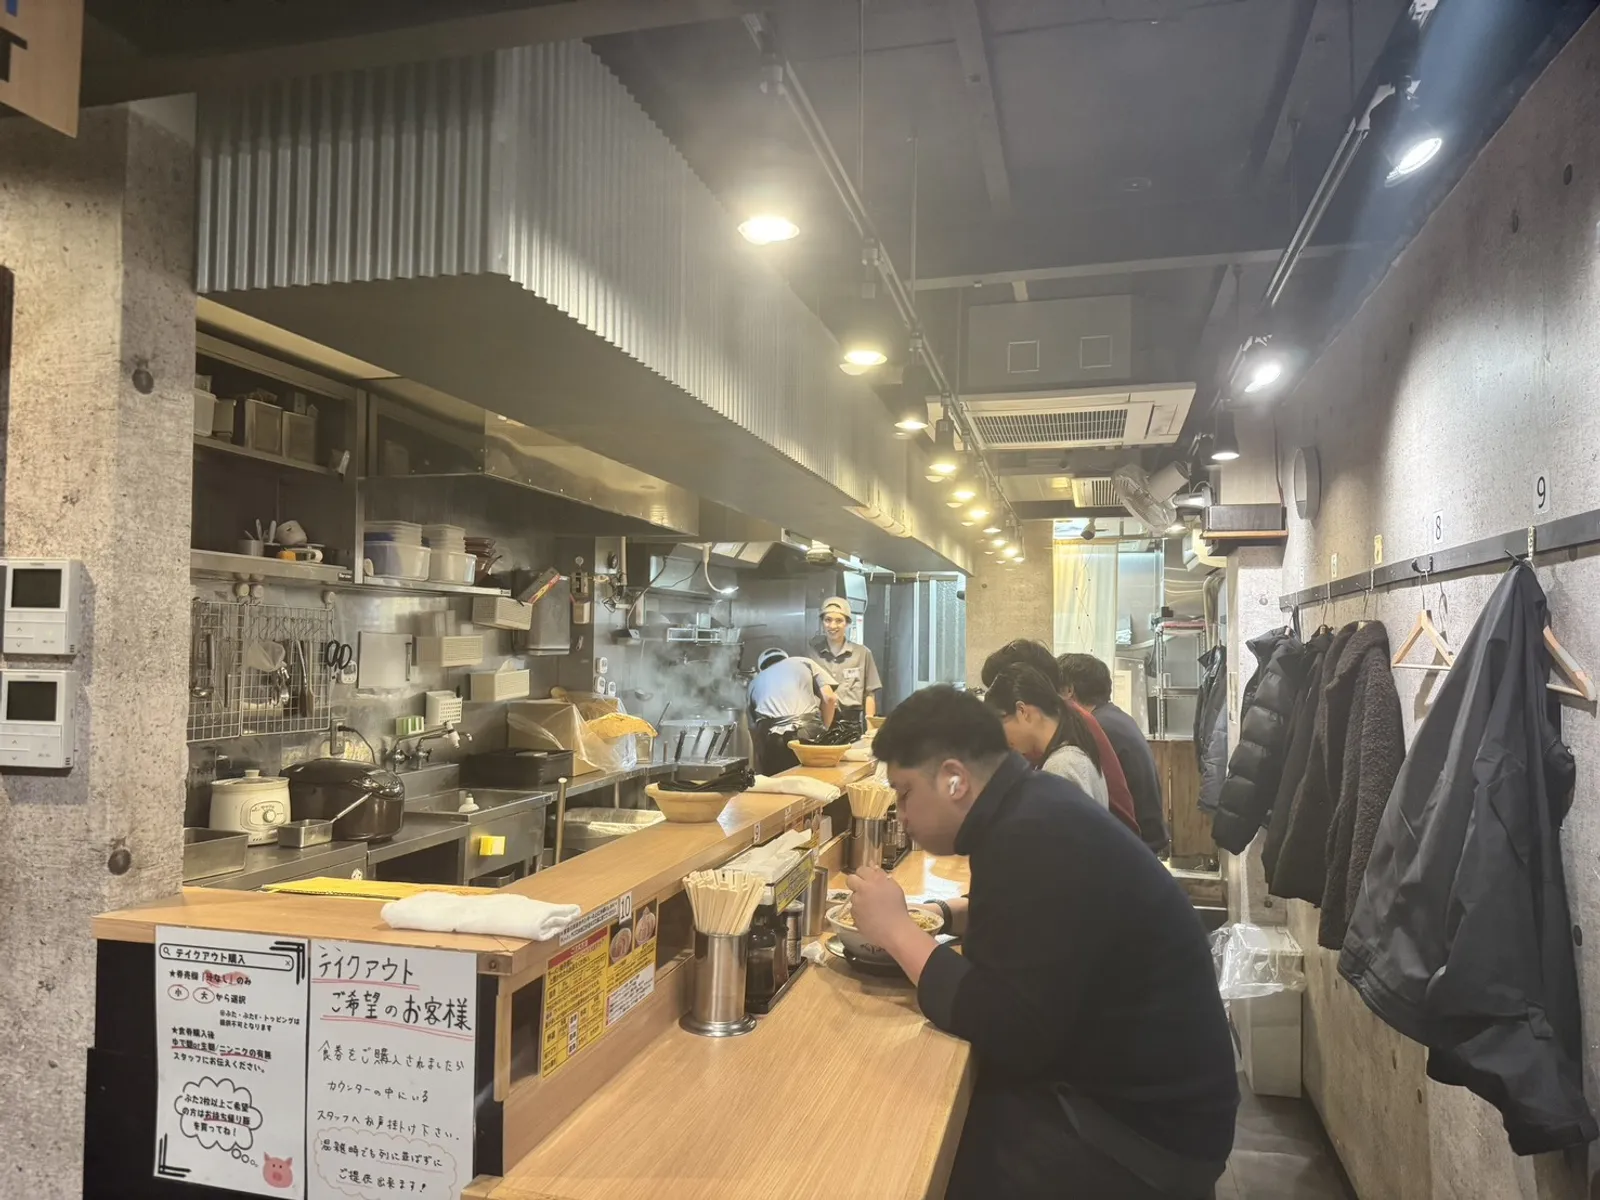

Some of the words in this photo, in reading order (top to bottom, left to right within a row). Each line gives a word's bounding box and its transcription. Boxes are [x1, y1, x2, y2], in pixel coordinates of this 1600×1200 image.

[1536, 476, 1546, 509] 9
[1435, 515, 1442, 540] 8
[620, 895, 631, 920] 10
[175, 948, 246, 965] テイクアウト購入
[318, 952, 414, 985] テイクアウト
[175, 988, 182, 997] 小
[200, 991, 208, 1000] 大
[215, 993, 247, 1004] から選択
[331, 989, 473, 1031] ご希望のお客様
[173, 1052, 265, 1073] スタッフにお伝えください。
[317, 1040, 465, 1072] 食券をご購入されましたら
[184, 1094, 249, 1113] ぶた2枚以上ご希望
[327, 1080, 429, 1103] カウンターの中にいる
